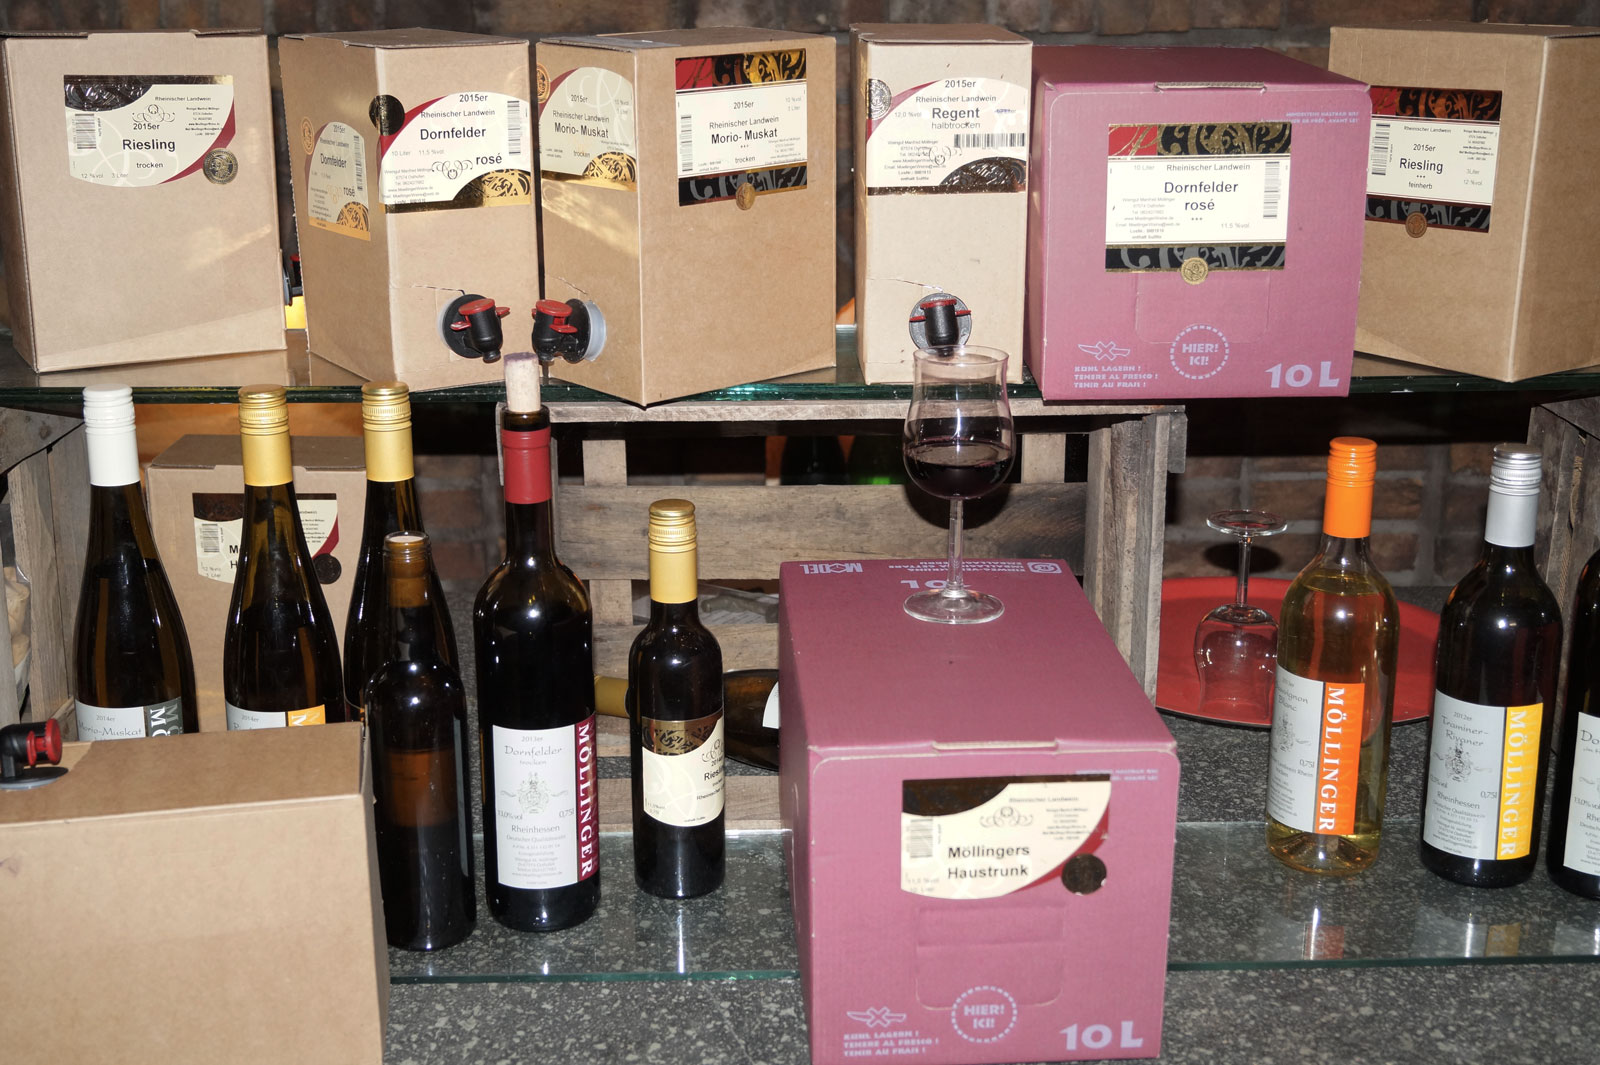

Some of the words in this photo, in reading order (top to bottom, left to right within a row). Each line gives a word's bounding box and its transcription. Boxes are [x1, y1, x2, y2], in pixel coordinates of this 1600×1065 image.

[944, 80, 976, 88] 2015er
[459, 94, 488, 103] 2015er
[571, 94, 588, 103] 2015er
[733, 100, 754, 109] 2015er
[420, 110, 461, 119] Rheinischer
[463, 109, 496, 117] Landwein
[553, 110, 583, 120] Rheinischer
[584, 114, 609, 123] Landwein
[932, 107, 980, 121] Regent
[333, 124, 346, 134] 2015er
[709, 120, 748, 129] Rheinischer
[749, 116, 779, 126] Landwein
[931, 121, 980, 129] halbtrocken
[420, 127, 487, 141] Dornfelder
[554, 122, 579, 134] Morio-
[580, 125, 608, 138] Muskat
[711, 133, 742, 144] Morio-
[744, 128, 778, 140] Muskat
[1404, 125, 1429, 133] Rheinischer
[1429, 126, 1451, 134] Landwein
[122, 139, 176, 152] Riesling
[1413, 143, 1436, 152] 2015er
[320, 153, 347, 168] Dornfelder
[475, 153, 503, 166] rosé
[573, 150, 591, 158] trocken
[735, 156, 756, 164] trocken
[1166, 163, 1212, 171] Rheinischer
[1213, 163, 1250, 171] Landwein
[1399, 157, 1443, 175] Riesling
[343, 186, 356, 197] rosé
[1164, 181, 1239, 194] Dornfelder
[1408, 181, 1433, 190] feinherb
[1184, 199, 1215, 211] rosé
[1181, 343, 1219, 353] HIER!
[1189, 355, 1209, 366] ICI!
[1445, 729, 1484, 746] Rivaner
[504, 745, 562, 758] Dornfelder
[1319, 687, 1347, 831] MÖLLINGER
[1501, 710, 1528, 856] MÖLLINGER
[578, 722, 593, 877] MÖLLINGER
[1437, 790, 1480, 810] Rheinhessen
[511, 825, 560, 833] Rheinhessen
[947, 845, 1030, 860] Möllingers
[947, 864, 1029, 879] Haustrunk
[963, 1004, 1005, 1017] HIER!
[972, 1018, 995, 1029] ICI!
